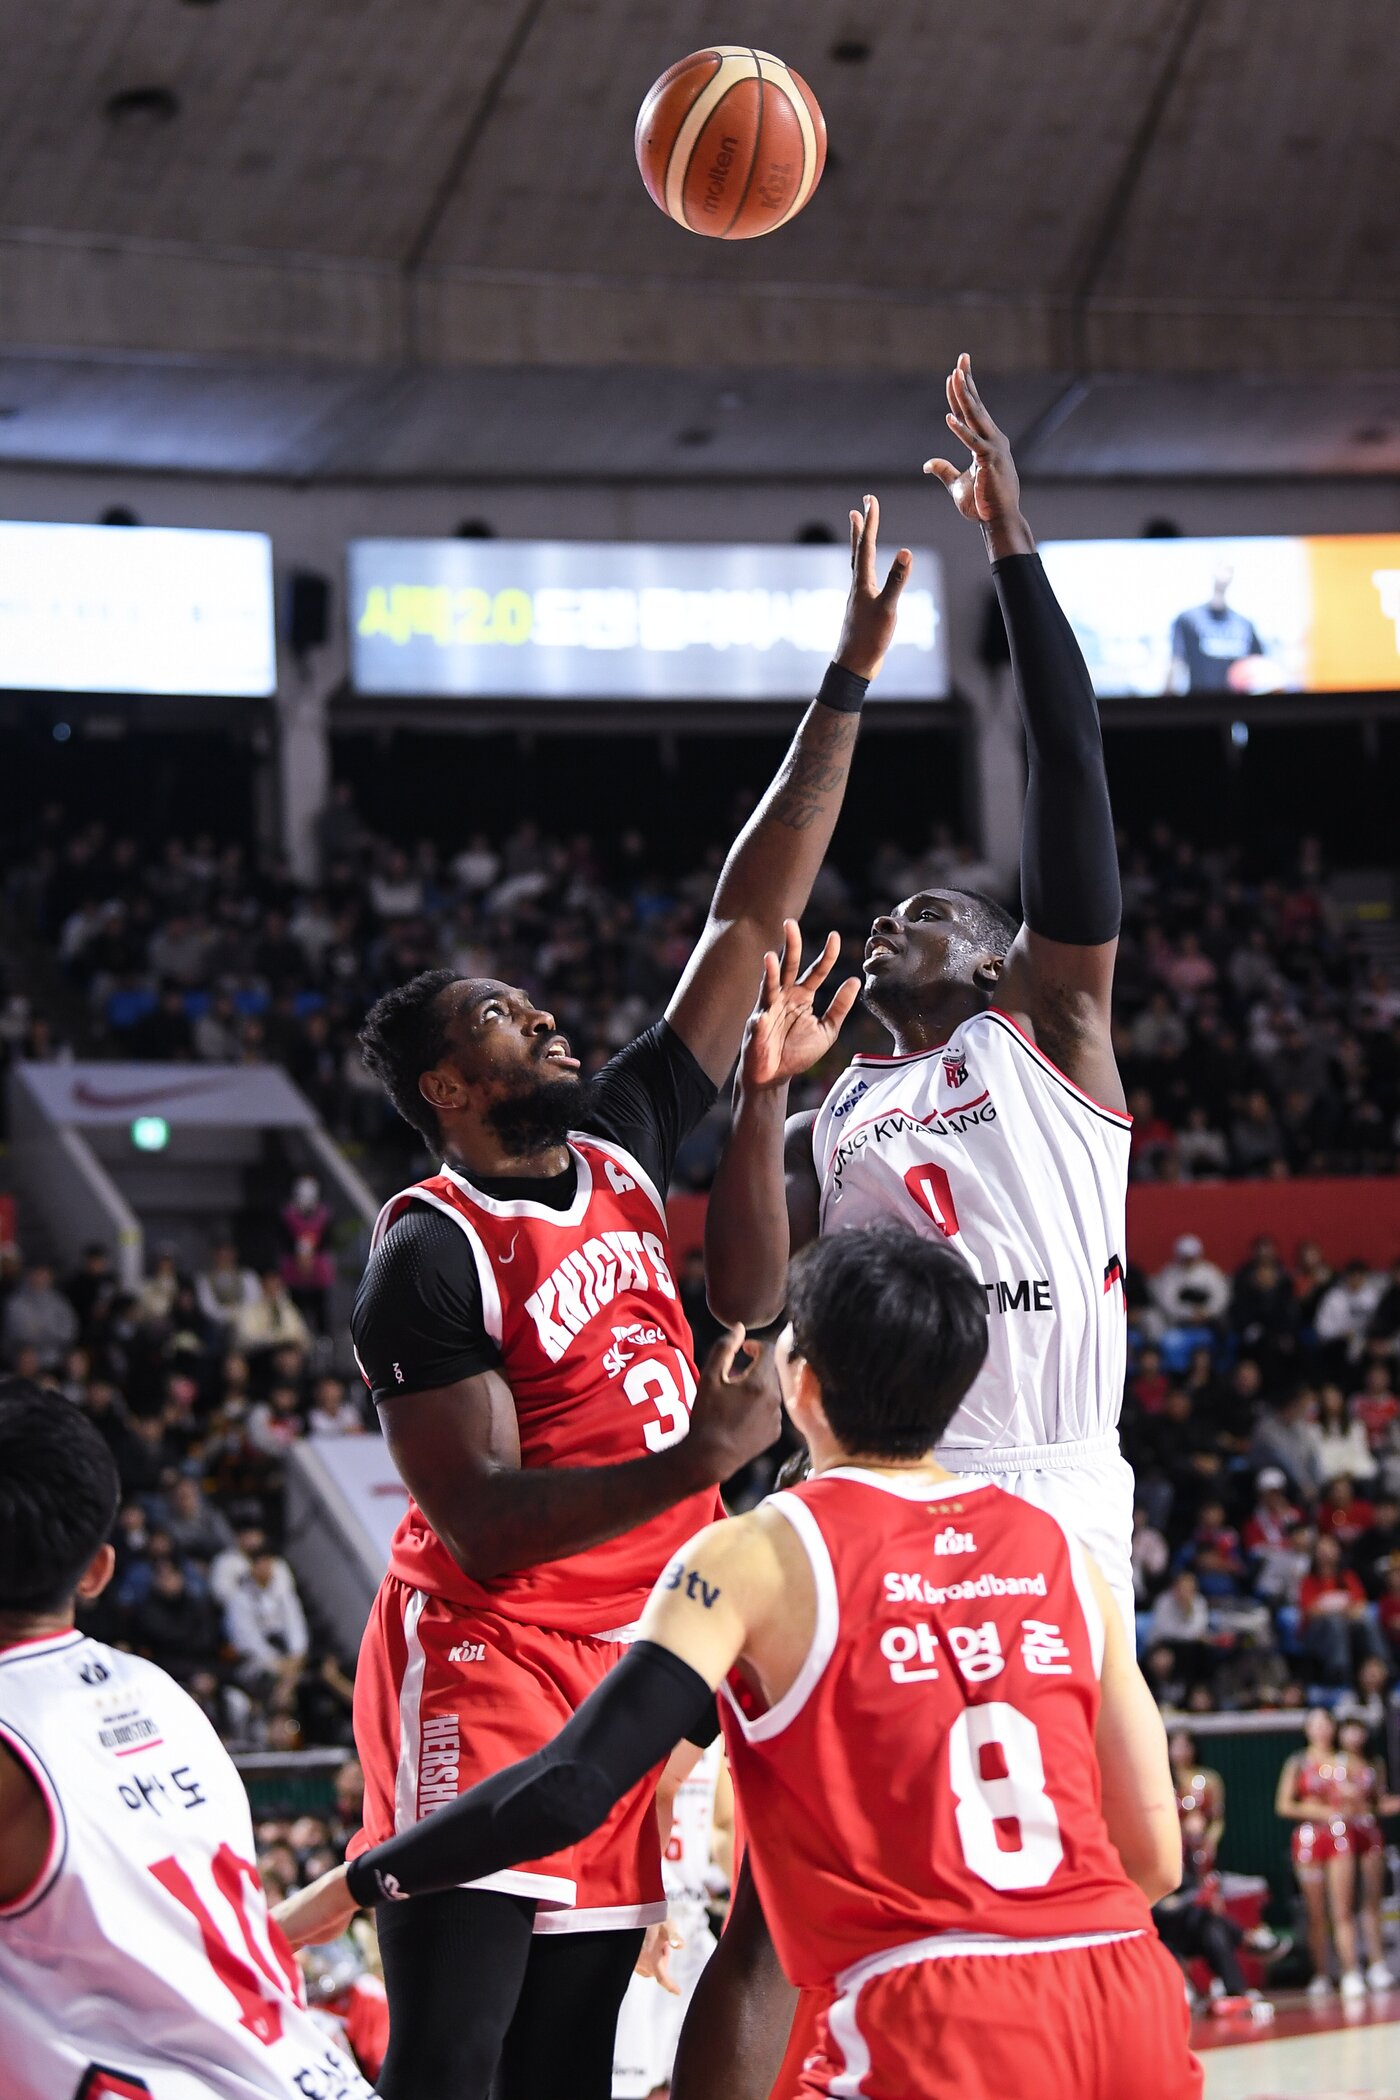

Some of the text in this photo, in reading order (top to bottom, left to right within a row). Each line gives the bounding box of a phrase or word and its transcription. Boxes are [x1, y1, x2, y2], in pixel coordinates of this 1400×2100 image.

[703, 137, 739, 215] molten
[833, 1130, 869, 1189] JUNG
[903, 1162, 960, 1238] 0
[602, 1341, 635, 1379] SK
[448, 1640, 486, 1662] KBL
[949, 1701, 1064, 1890] 8
[147, 1841, 306, 2046] 10
